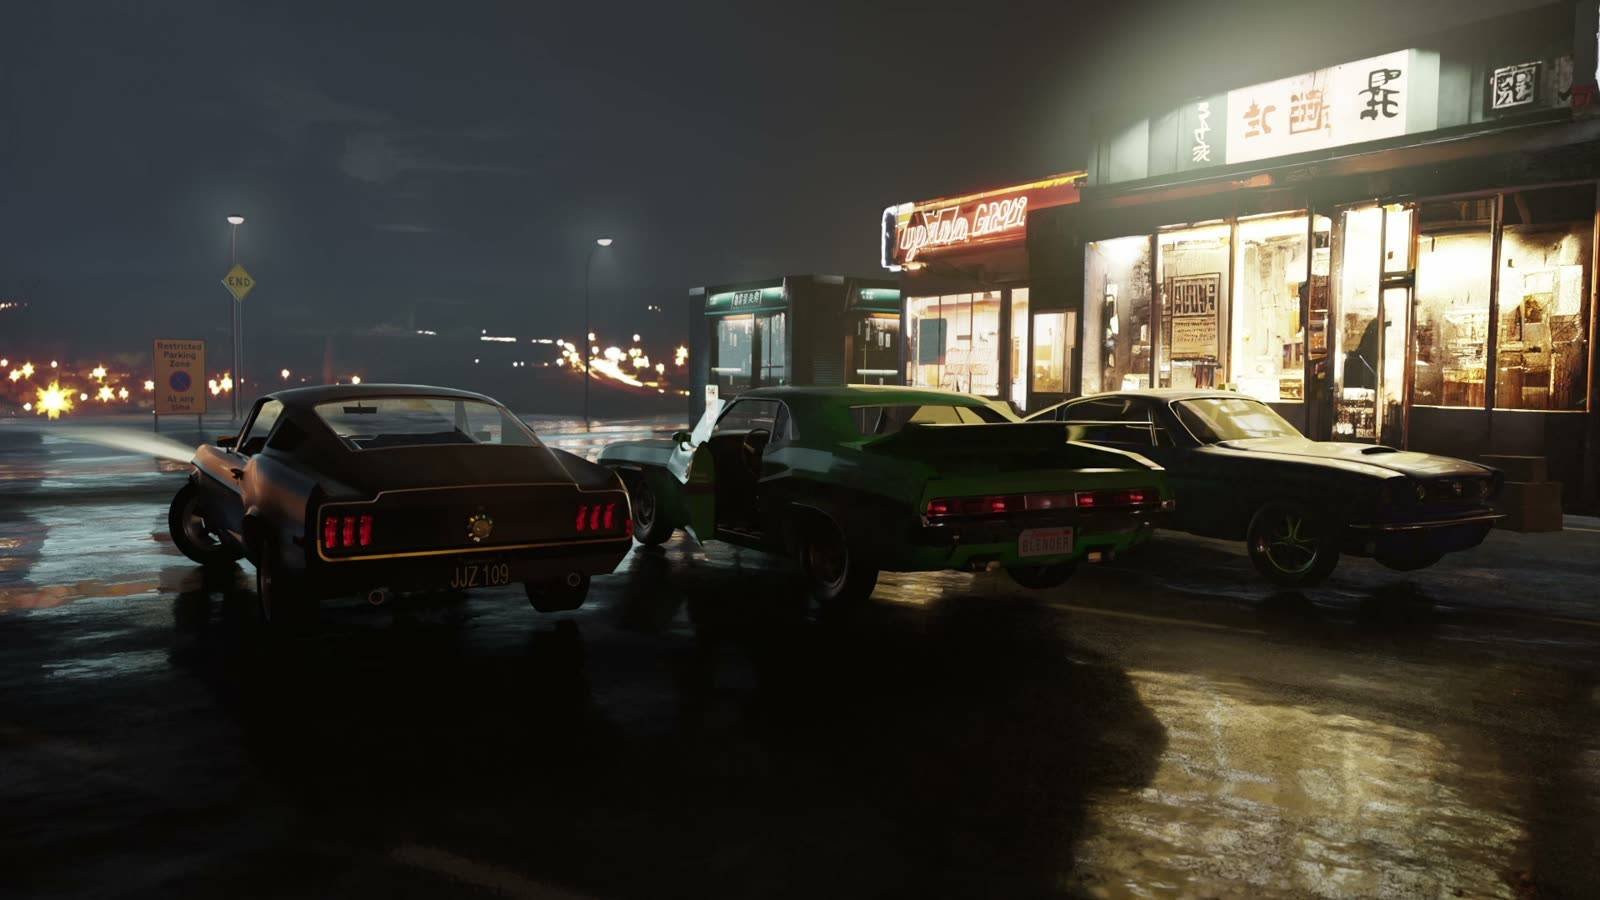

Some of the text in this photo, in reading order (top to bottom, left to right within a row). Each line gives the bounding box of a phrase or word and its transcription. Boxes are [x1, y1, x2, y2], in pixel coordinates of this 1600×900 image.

[228, 276, 250, 288] END
[157, 342, 202, 350] Restricted
[163, 351, 197, 360] Parking
[169, 360, 191, 368] Zone
[450, 563, 510, 588] JJZ 109
